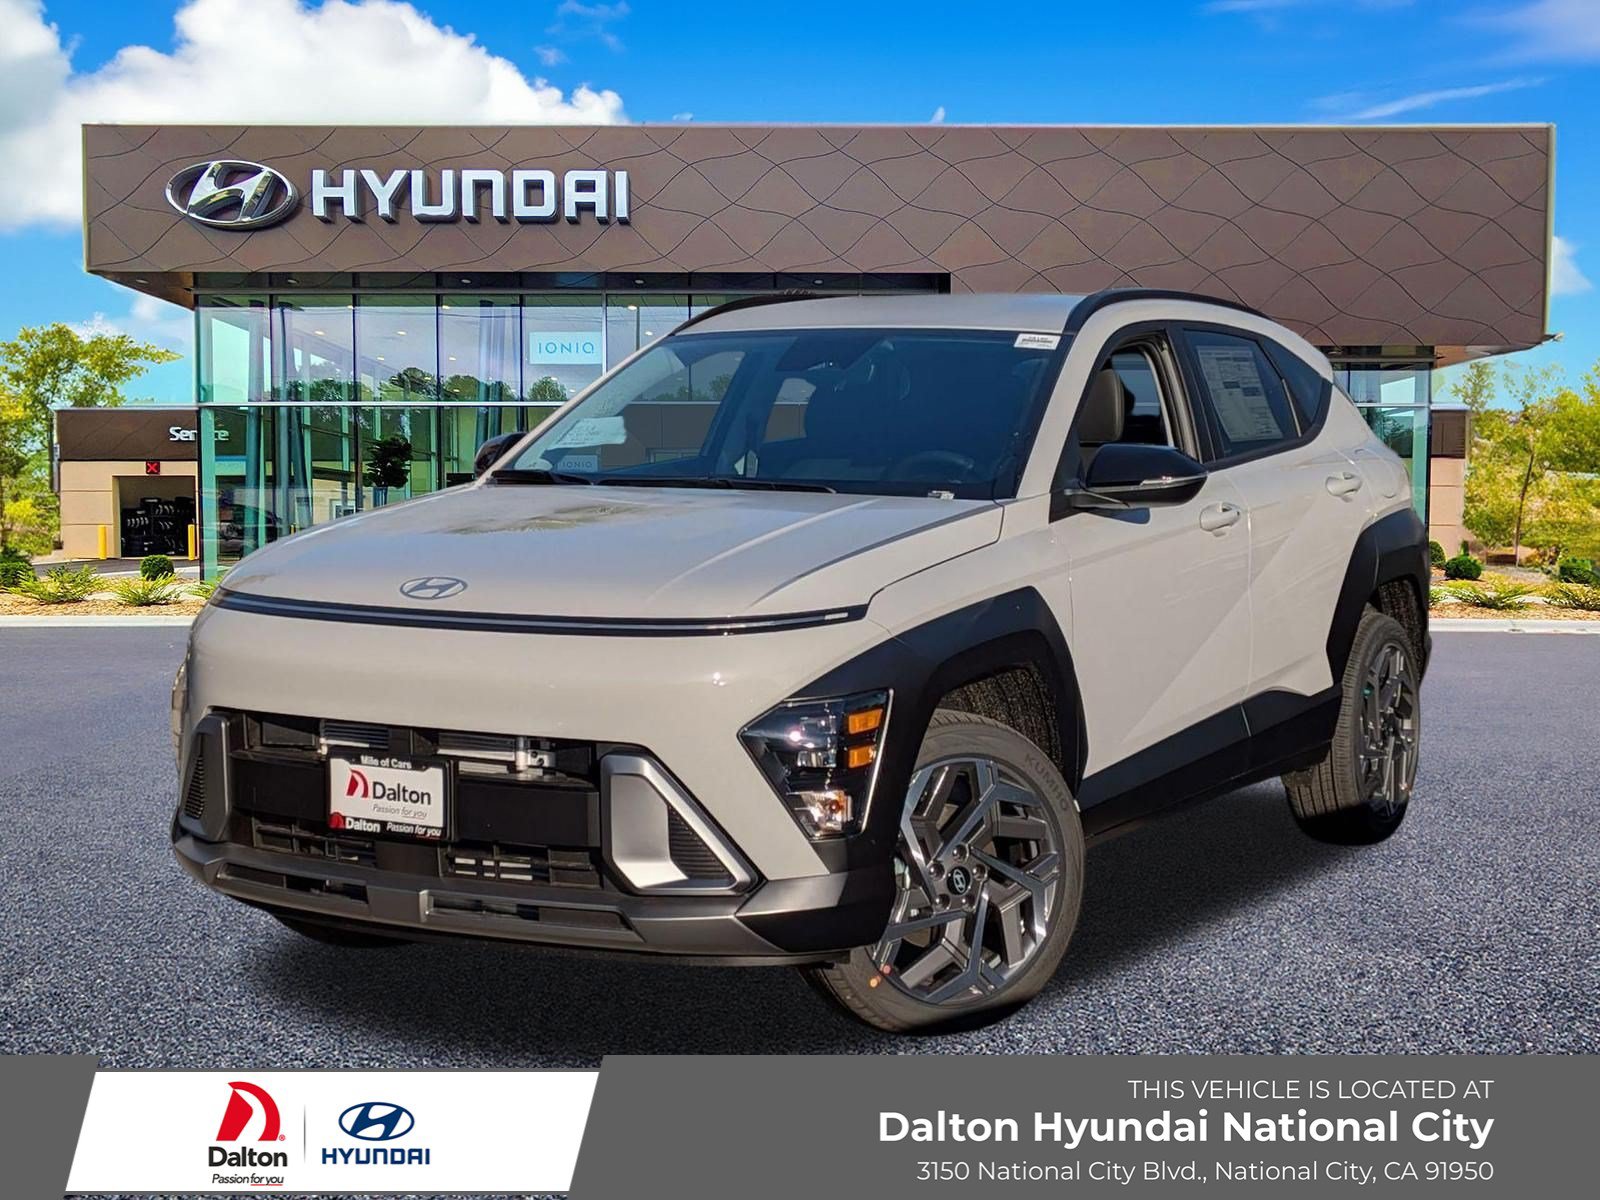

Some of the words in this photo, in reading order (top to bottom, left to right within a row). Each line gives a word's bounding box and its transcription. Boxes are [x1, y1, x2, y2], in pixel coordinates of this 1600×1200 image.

[311, 168, 631, 223] HYUNDAI
[538, 341, 595, 355] IONIQ
[361, 755, 379, 766] Mile
[380, 757, 390, 767] of
[391, 758, 412, 769] Cars
[1023, 753, 1069, 811] KUMHO
[373, 782, 431, 805] Dalton
[373, 804, 400, 815] Passion
[401, 806, 413, 816] for
[413, 810, 428, 819] you
[346, 817, 380, 832] Dalton
[387, 822, 414, 833] Passion
[414, 824, 427, 835] for
[427, 828, 441, 837] you
